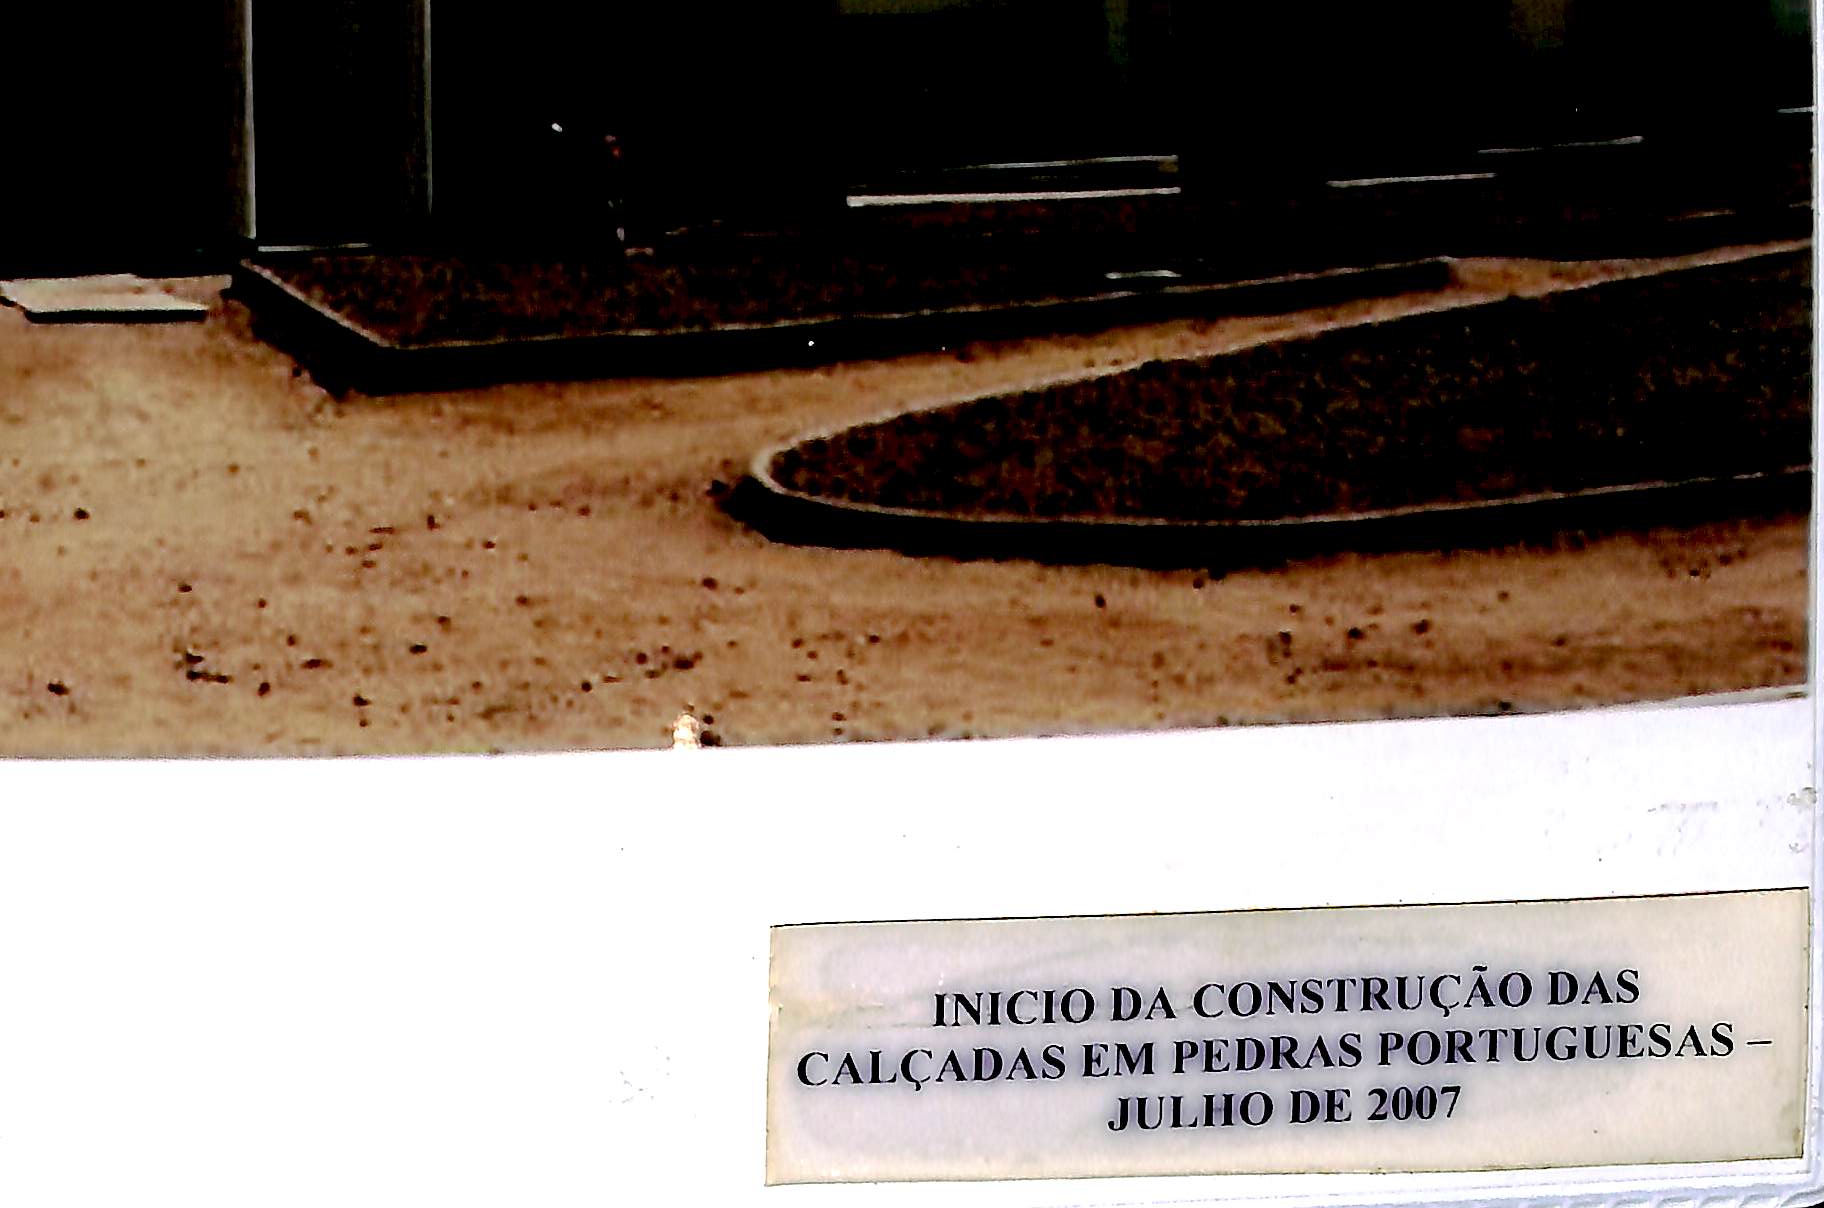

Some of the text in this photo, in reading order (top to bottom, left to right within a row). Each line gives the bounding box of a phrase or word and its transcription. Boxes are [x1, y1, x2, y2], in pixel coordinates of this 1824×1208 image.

[932, 965, 1640, 1027] INICIO DA CONSTRUÇÃO DAS
[796, 1044, 1066, 1092] CALÇADAS
[1081, 1042, 1155, 1078] EM
[1172, 1032, 1363, 1074] PEDRAS
[1377, 1022, 1734, 1066] PORTUGUESAS
[1107, 1085, 1462, 1132] JULHO DE 2007
